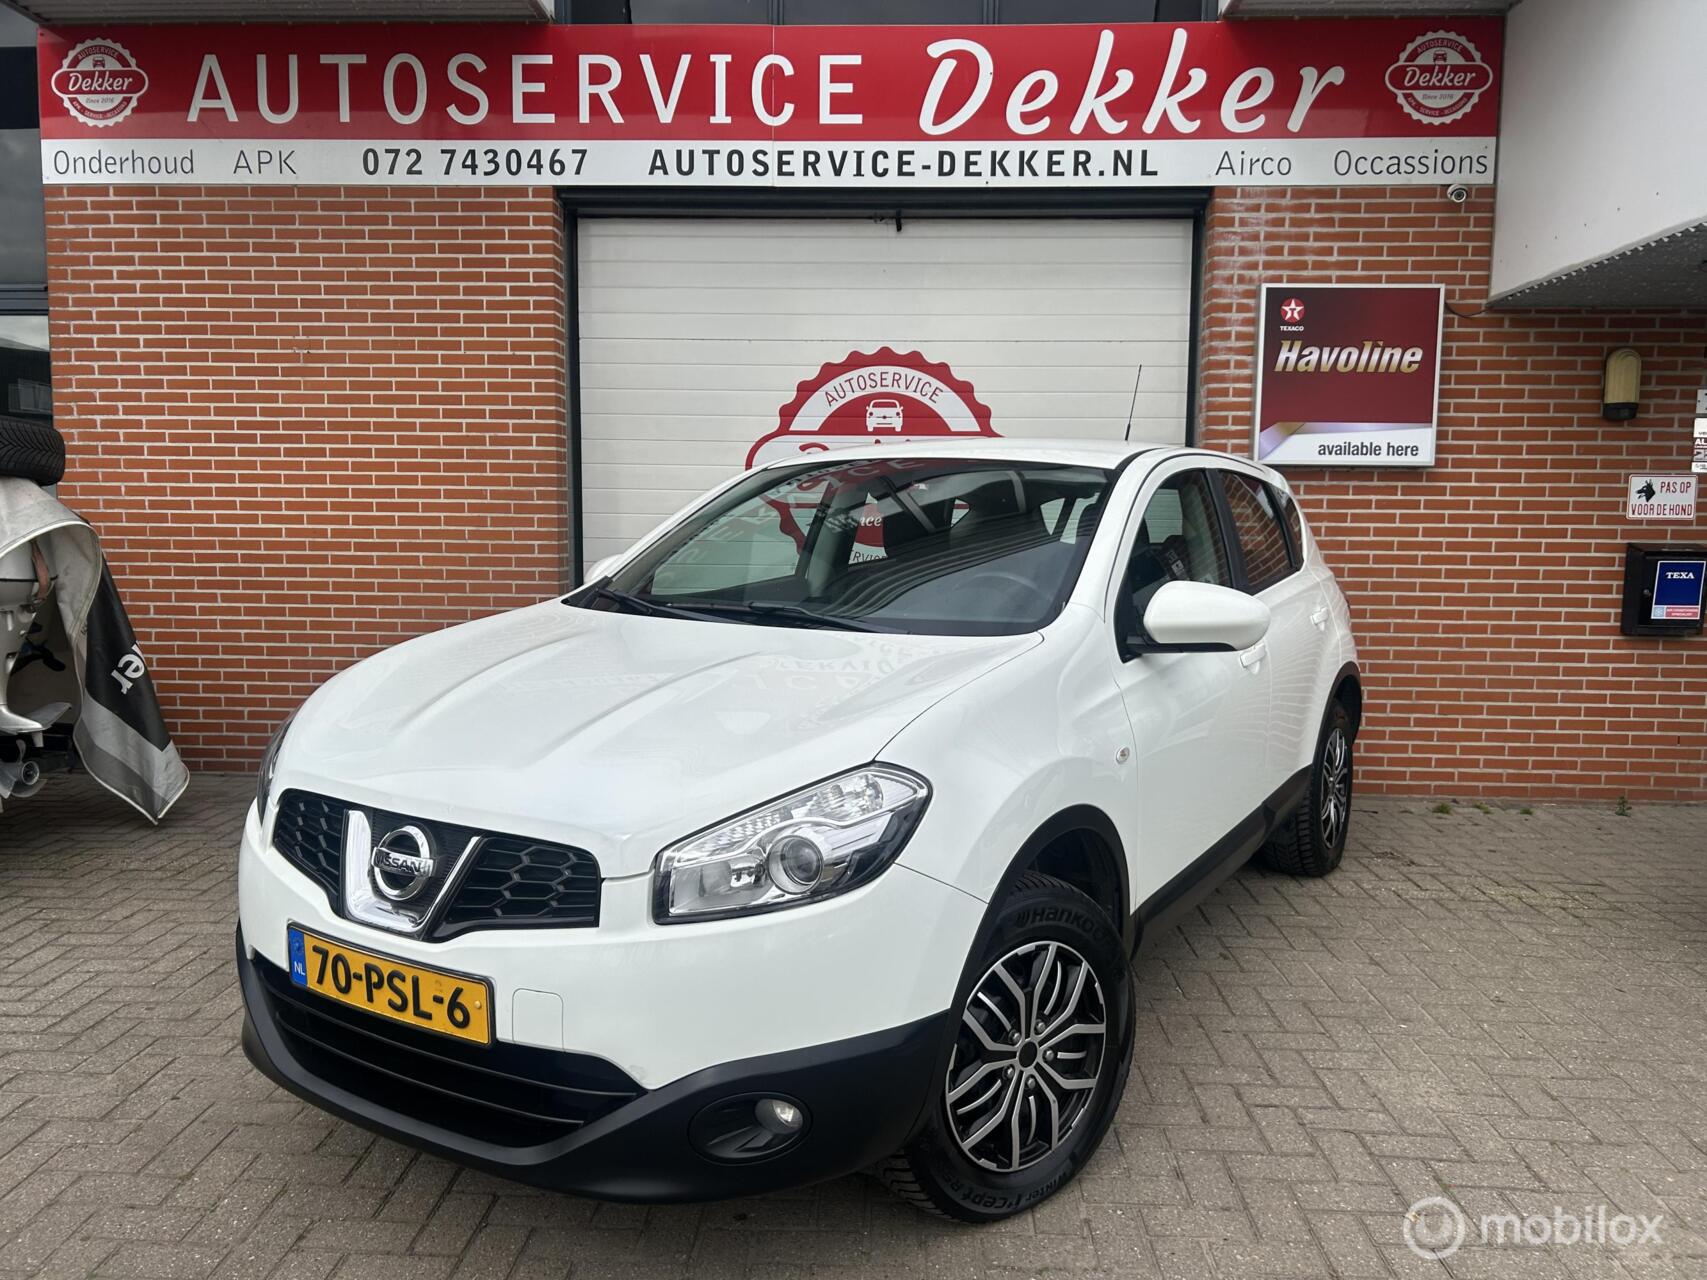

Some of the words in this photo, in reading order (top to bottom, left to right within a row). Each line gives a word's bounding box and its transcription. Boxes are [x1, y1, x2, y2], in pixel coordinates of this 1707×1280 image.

[77, 46, 119, 60] AUTOSERVICE
[1416, 39, 1463, 54] AUTOSERVICE
[68, 71, 133, 91] Dekker
[187, 52, 863, 127] AUTOSERVICE
[919, 28, 1345, 136] Dekker
[1404, 65, 1476, 87] Dekker
[53, 148, 195, 176] Onderhoud
[233, 148, 297, 175] APK
[362, 148, 424, 176] 072
[440, 148, 588, 176] 7430467
[648, 147, 1159, 178] AUTOSERVICE-DEKKER.NL
[1215, 149, 1293, 177] Airco
[1333, 149, 1489, 176] Occassions
[1273, 339, 1424, 374] Havoline
[823, 371, 944, 408] AUTOSERVICE
[1318, 442, 1382, 456] available
[1386, 442, 1419, 457] here
[1660, 481, 1678, 494] PAS
[1680, 481, 1692, 494] OP
[1631, 503, 1655, 516] VOOR
[1656, 504, 1668, 516] DE
[1669, 504, 1693, 516] HOND
[1665, 571, 1695, 579] TEXA
[294, 961, 306, 976] NL
[312, 944, 471, 1029] 70-PSL-6
